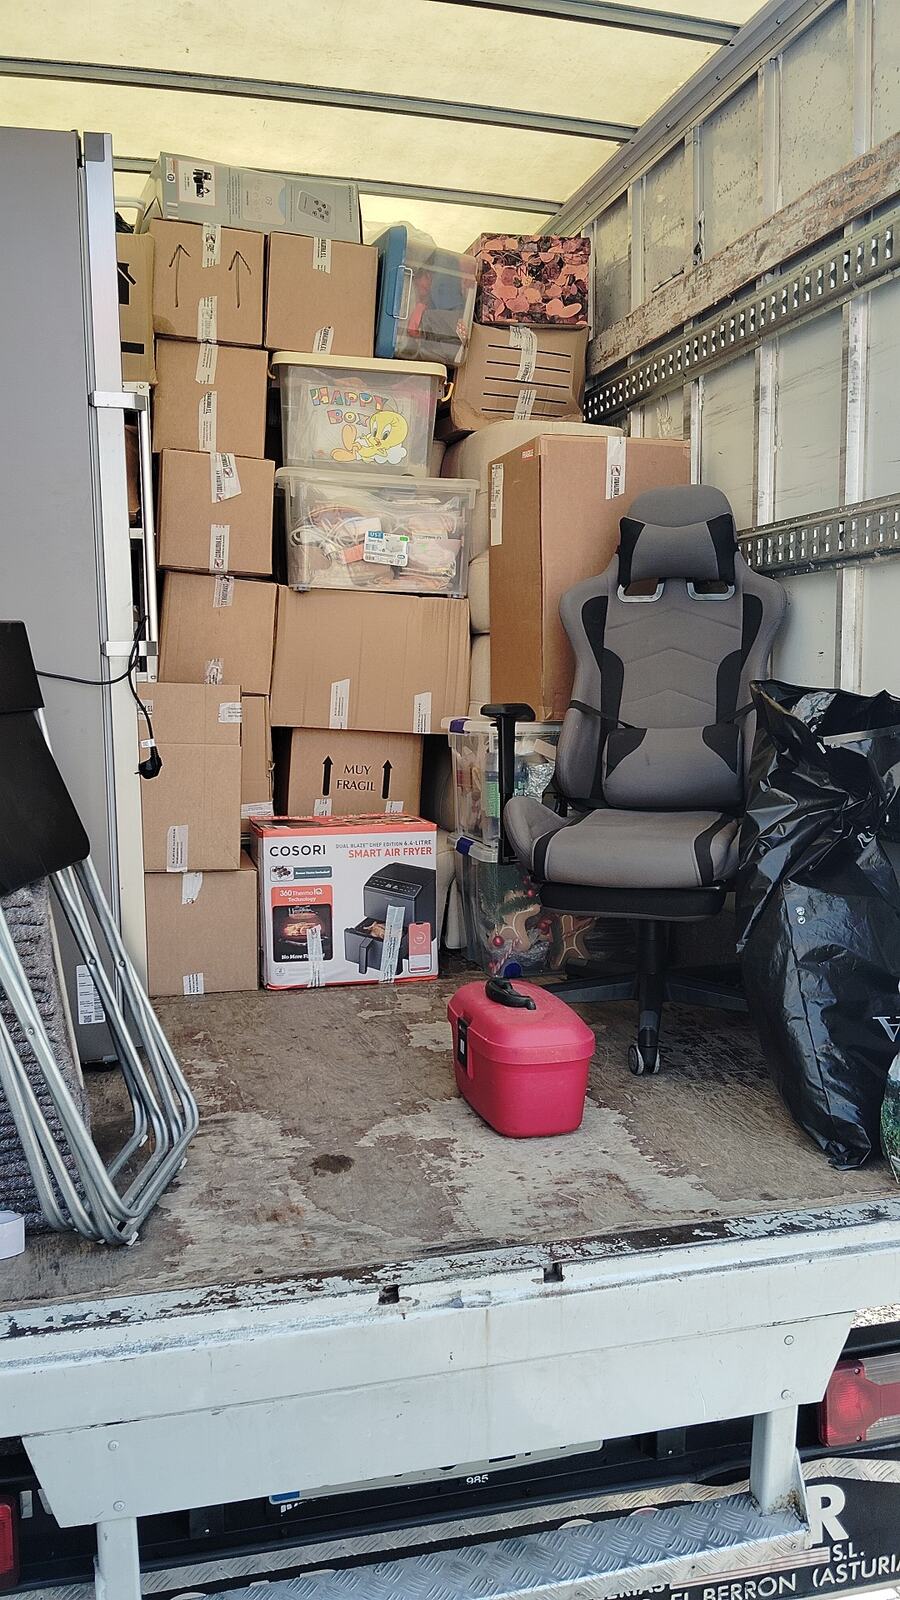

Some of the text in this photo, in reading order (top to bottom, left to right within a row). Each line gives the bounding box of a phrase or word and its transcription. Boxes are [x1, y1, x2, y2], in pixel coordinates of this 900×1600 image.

[310, 387, 389, 411] HAPPY
[327, 409, 370, 427] BOX
[344, 764, 371, 775] MUY
[336, 780, 376, 791] FRAGIL
[269, 844, 326, 857] COSORI
[348, 847, 432, 858] SMART AIR FRYER
[279, 889, 292, 897] 360
[466, 1474, 489, 1485] 985
[832, 1542, 865, 1561] S.L.
[812, 1554, 900, 1588] (ASTURI
